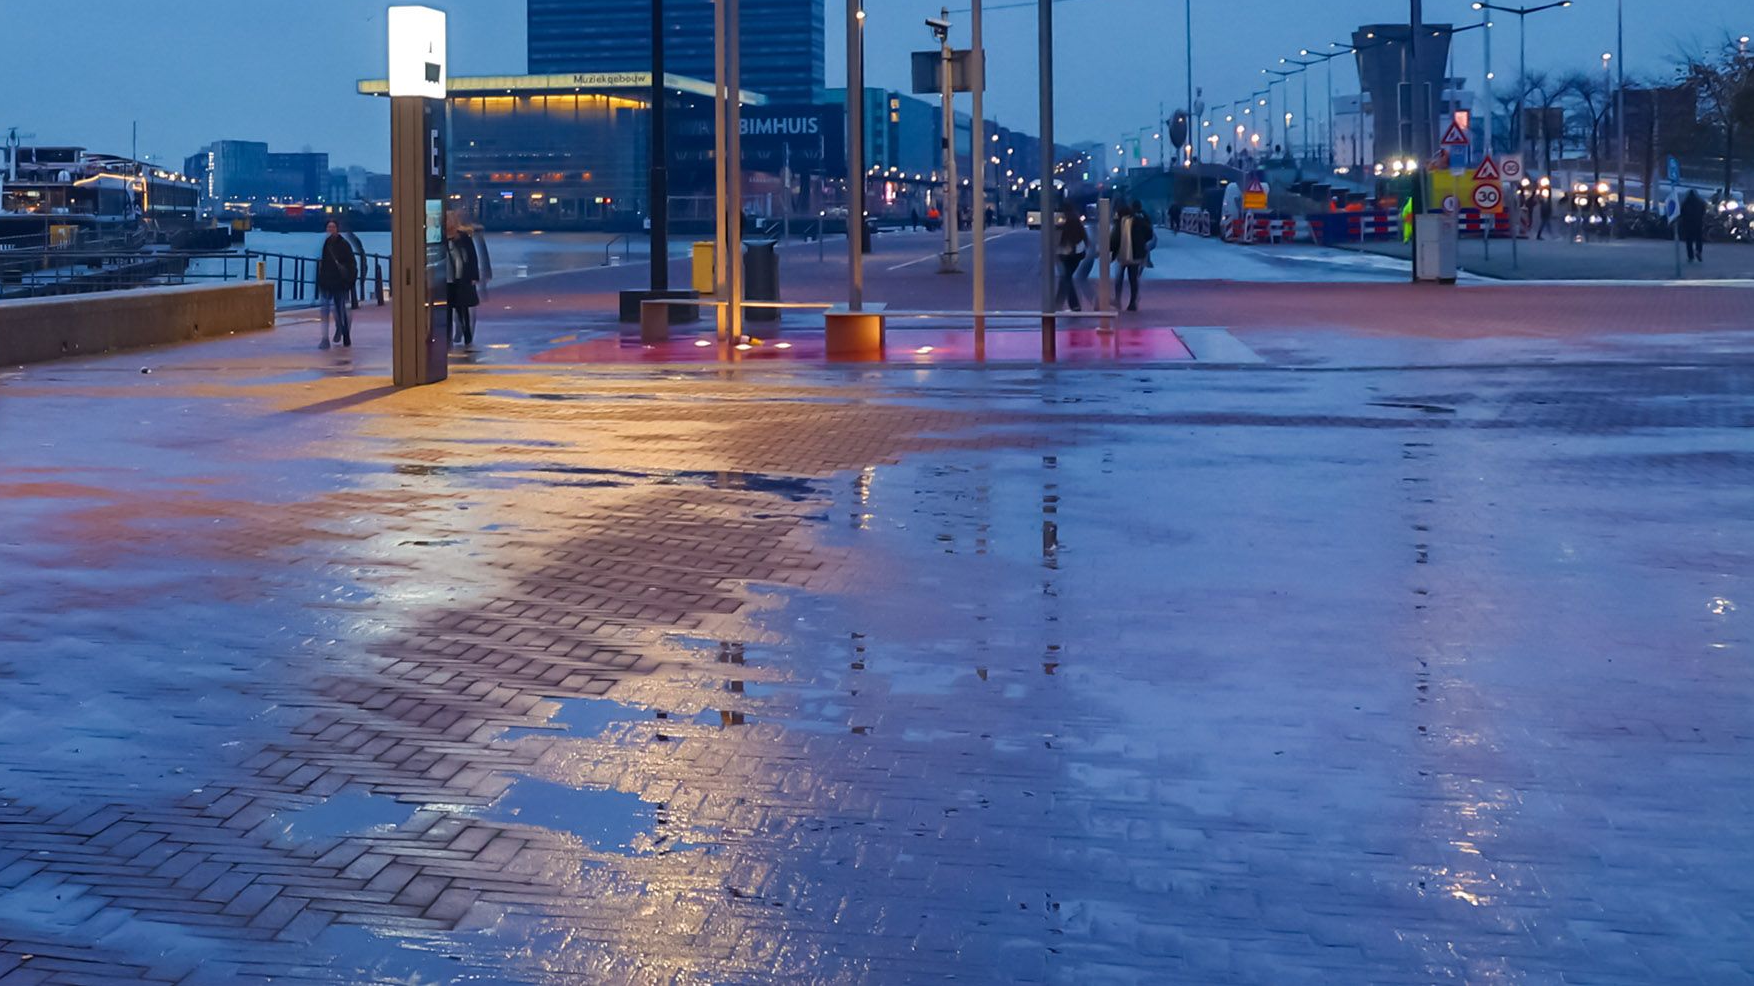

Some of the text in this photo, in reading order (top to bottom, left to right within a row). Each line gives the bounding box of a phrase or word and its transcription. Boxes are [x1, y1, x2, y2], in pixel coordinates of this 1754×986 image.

[573, 74, 646, 86] Muziekgebouw
[740, 117, 819, 135] BIMHUIS
[1477, 191, 1497, 202] 30
